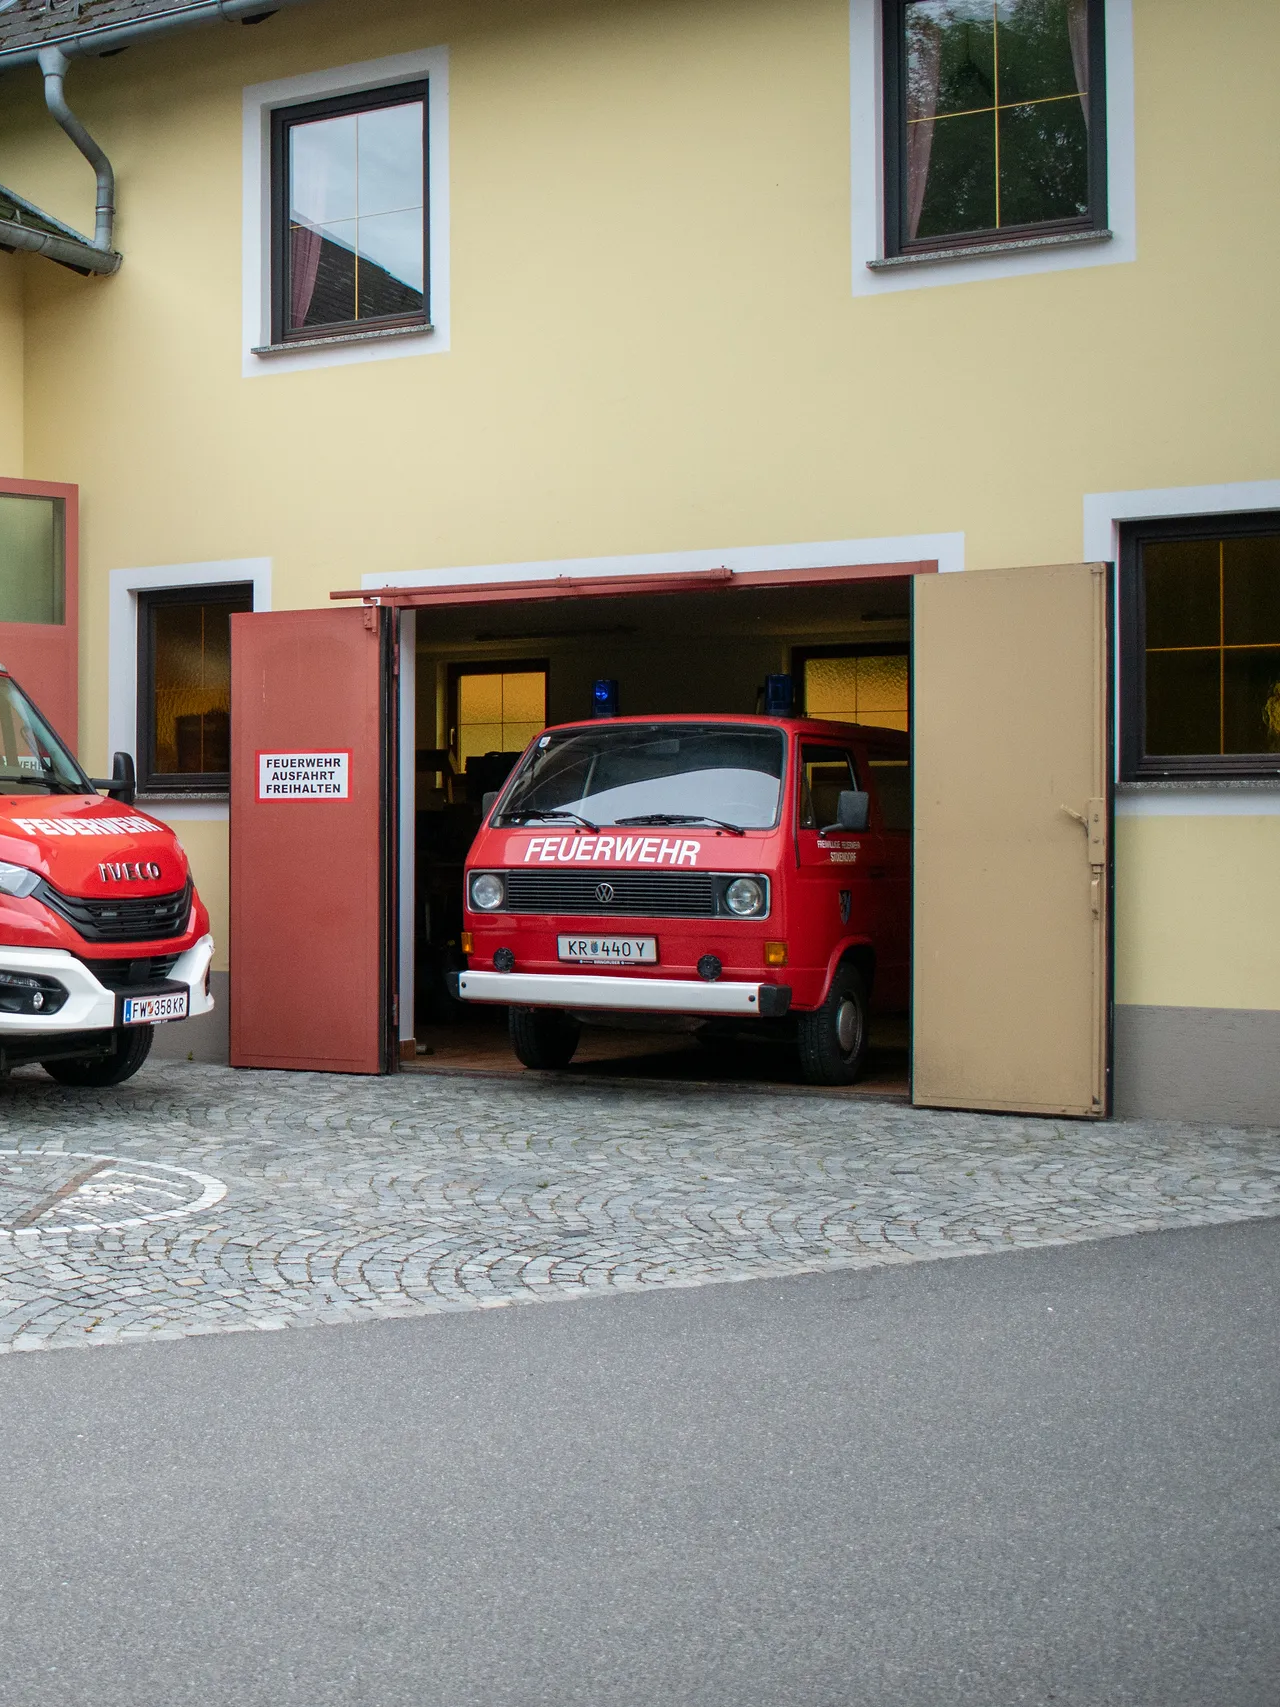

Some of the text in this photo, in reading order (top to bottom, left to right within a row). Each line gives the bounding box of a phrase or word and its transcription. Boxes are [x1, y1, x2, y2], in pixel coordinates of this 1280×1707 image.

[266, 758, 341, 769] FEUERWEHR
[271, 771, 335, 781] AUSFAHRT
[266, 784, 341, 794] FREIHALTEN
[10, 816, 164, 836] FEUERWEHR
[523, 836, 701, 866] FEUERWEHR
[98, 861, 161, 882] IVECO
[568, 940, 645, 957] KR 440 Y
[132, 1002, 148, 1018] FW
[154, 1000, 172, 1016] 358
[173, 997, 185, 1013] KR
